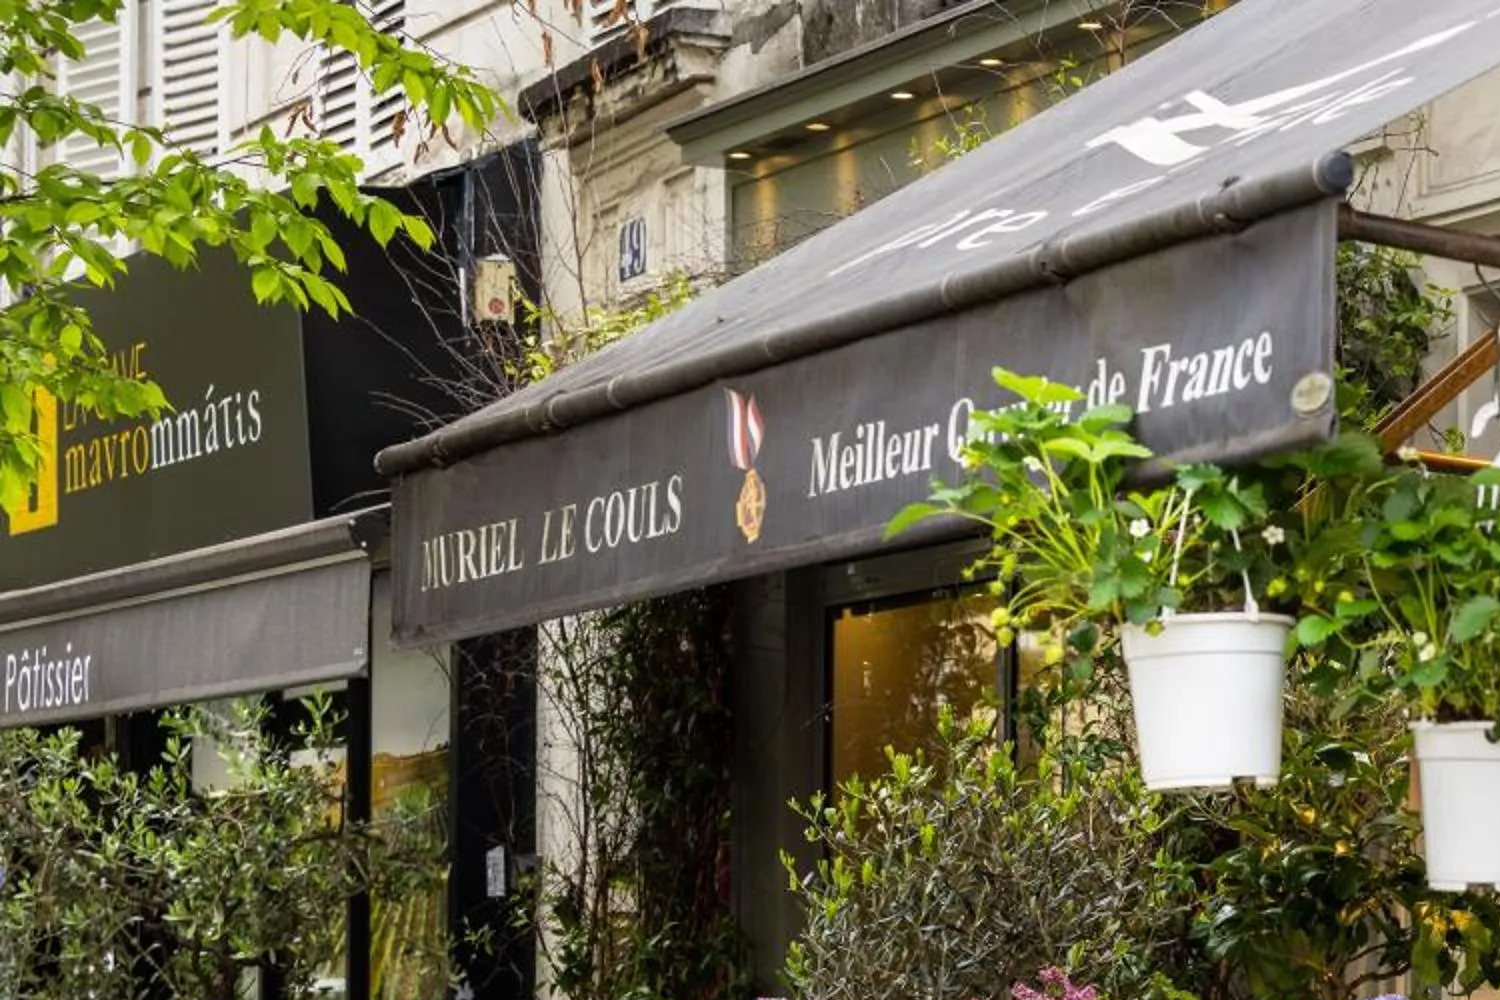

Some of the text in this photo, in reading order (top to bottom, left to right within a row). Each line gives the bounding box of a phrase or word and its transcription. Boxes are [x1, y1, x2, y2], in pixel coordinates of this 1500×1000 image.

[807, 419, 939, 497] Meilleur
[1136, 331, 1273, 414] France
[421, 474, 683, 592] MURIEL LE COULS
[5, 641, 91, 713] Pâtissier
